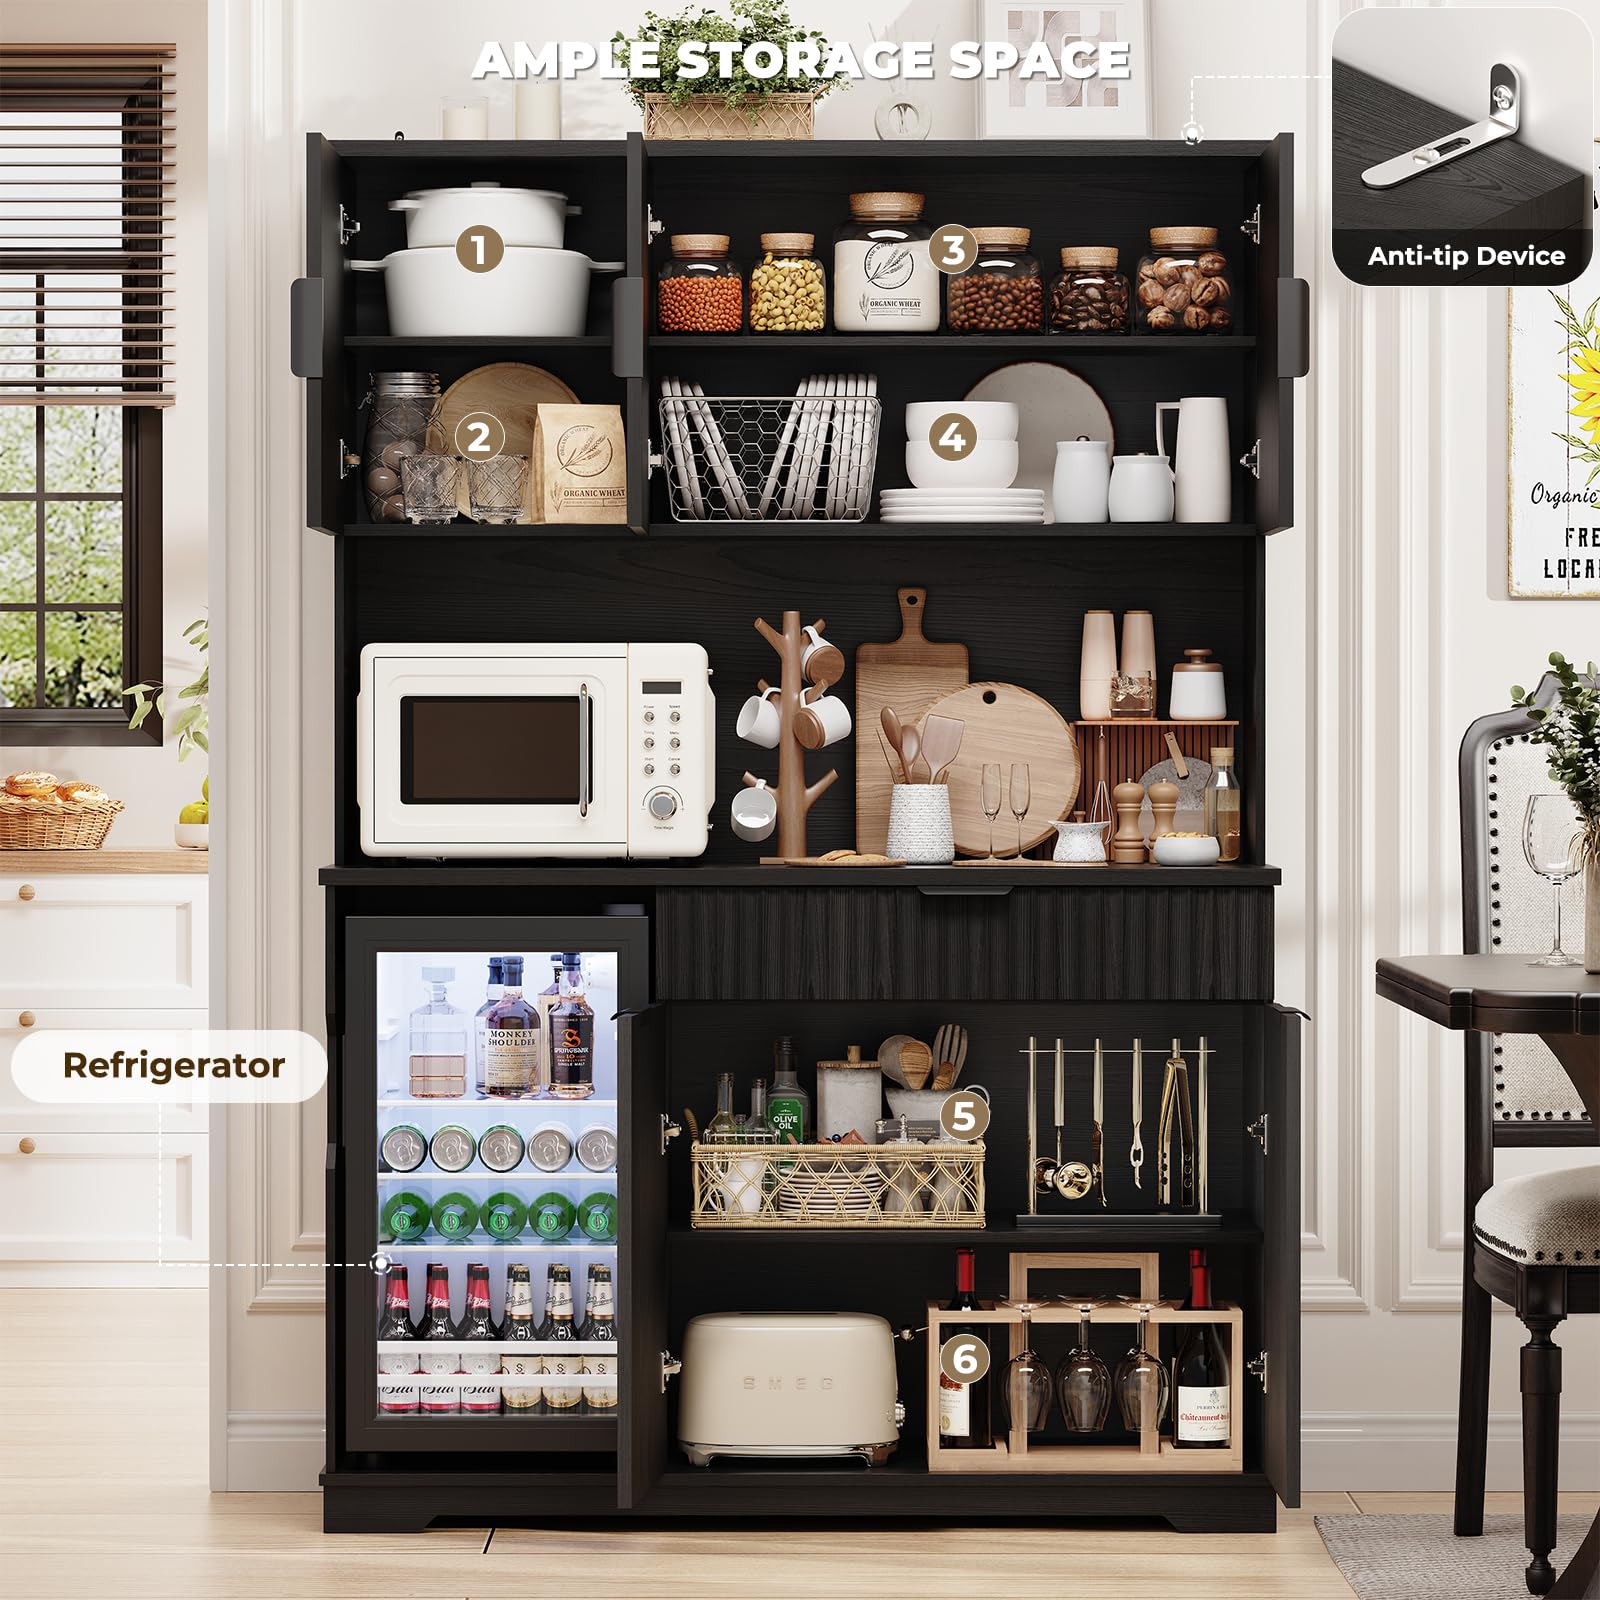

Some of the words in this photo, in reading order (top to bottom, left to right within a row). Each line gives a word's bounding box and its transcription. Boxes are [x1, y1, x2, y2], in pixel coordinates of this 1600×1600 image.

[599, 489, 625, 497] WHEAT
[1531, 482, 1598, 509] Organic
[1544, 559, 1600, 579] LOCA
[773, 1115, 798, 1123] OLIVE
[778, 1122, 793, 1130] OIL
[743, 1377, 833, 1390] SMEG
